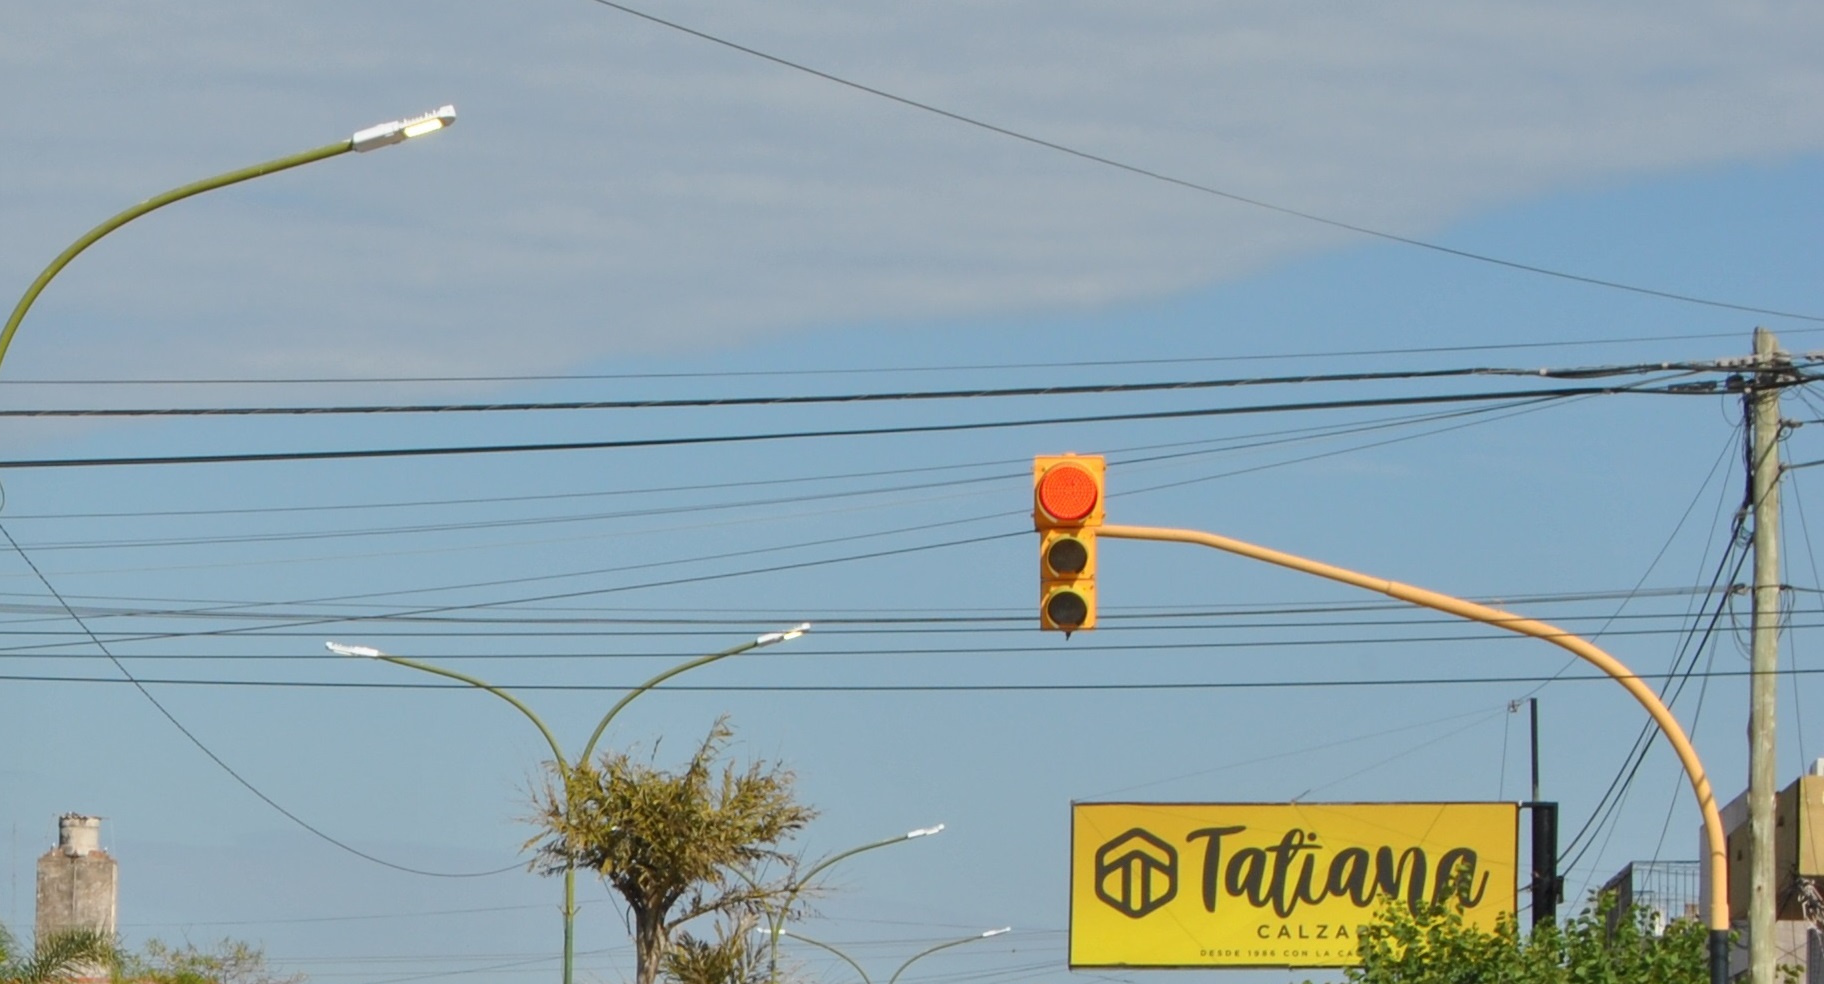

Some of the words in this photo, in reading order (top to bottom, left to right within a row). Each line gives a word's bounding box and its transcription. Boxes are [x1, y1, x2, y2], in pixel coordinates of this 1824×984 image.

[1186, 825, 1489, 919] Tatiana
[1200, 949, 1241, 958] DESDE
[1247, 949, 1276, 958] 1986
[1283, 949, 1309, 958] CON
[1315, 949, 1330, 958] LA
